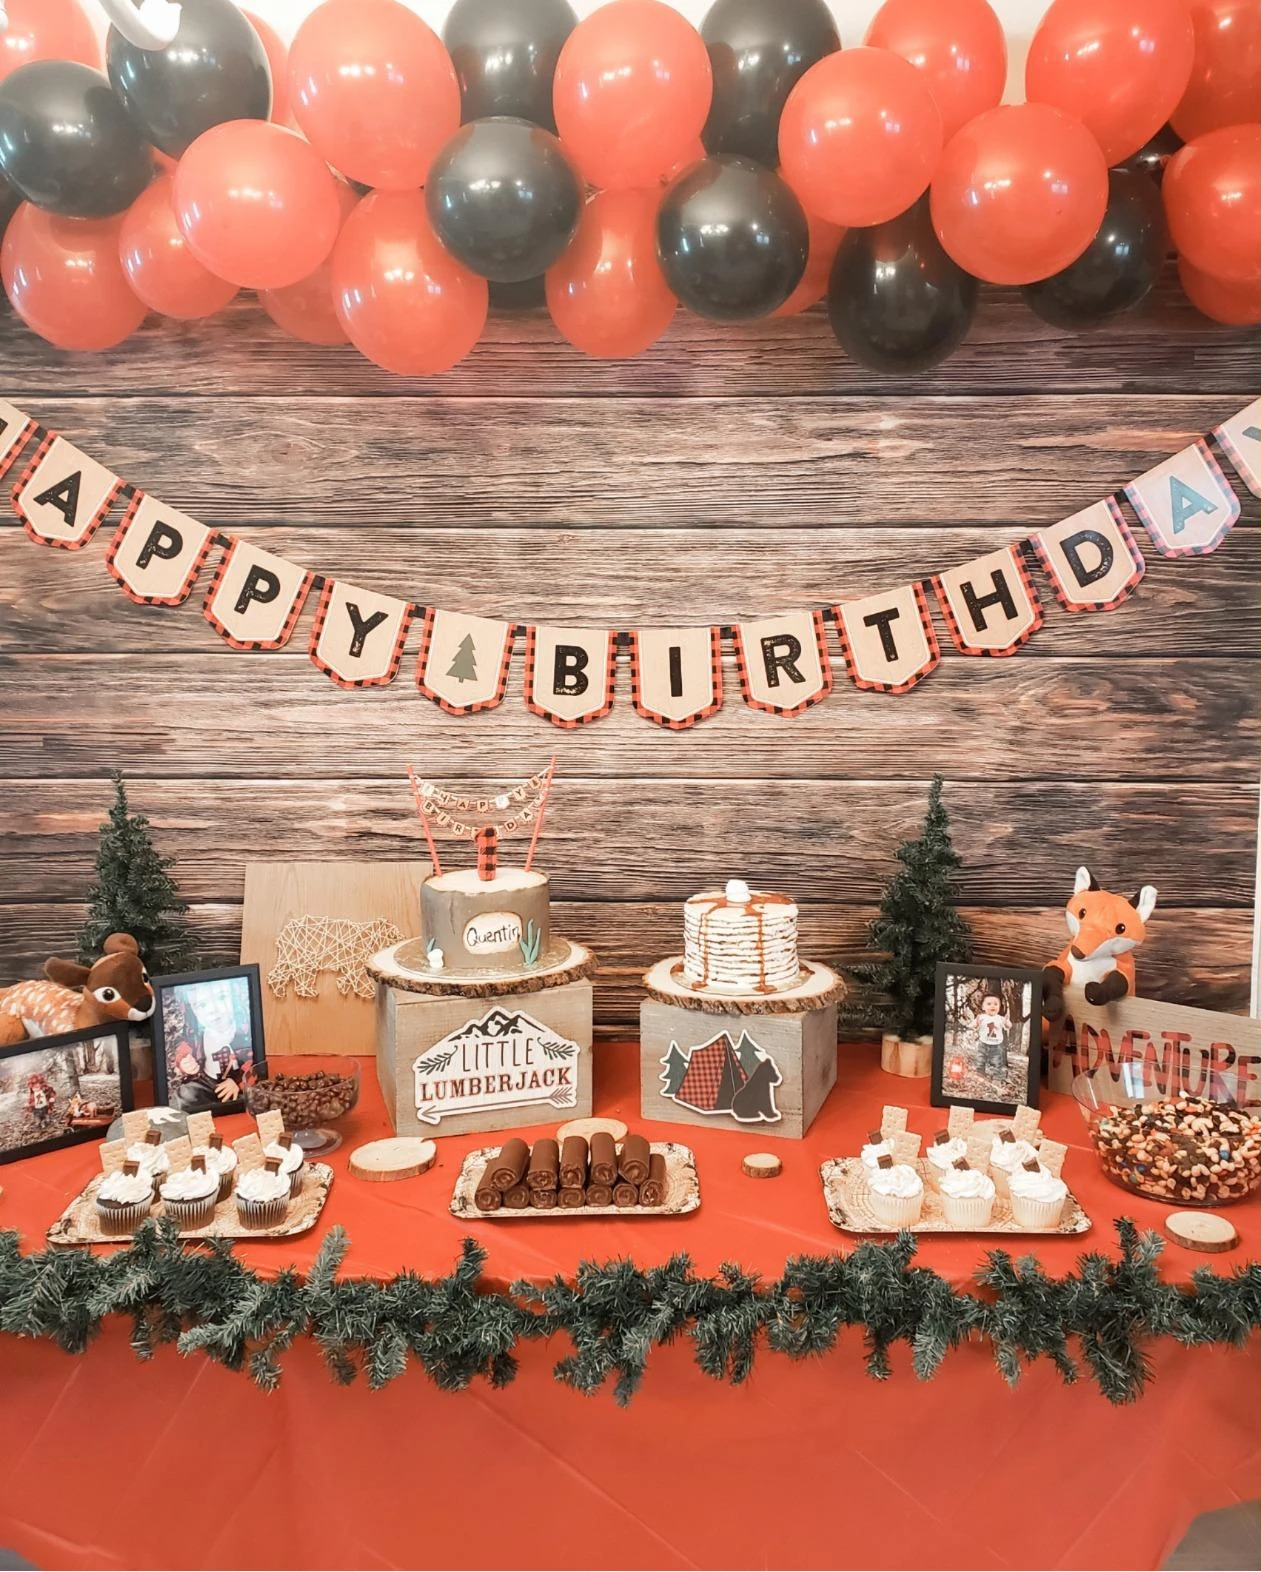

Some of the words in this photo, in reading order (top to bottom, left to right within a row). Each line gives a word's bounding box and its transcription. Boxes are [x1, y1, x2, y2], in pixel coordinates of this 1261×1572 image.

[0, 418, 389, 658] APPY
[554, 426, 1261, 697] BIRTHDA
[466, 924, 520, 947] Quentin
[462, 1037, 535, 1072] LITTLE
[1052, 1014, 1261, 1109] ADVENTURE
[420, 1066, 573, 1103] LUMBERJACK
